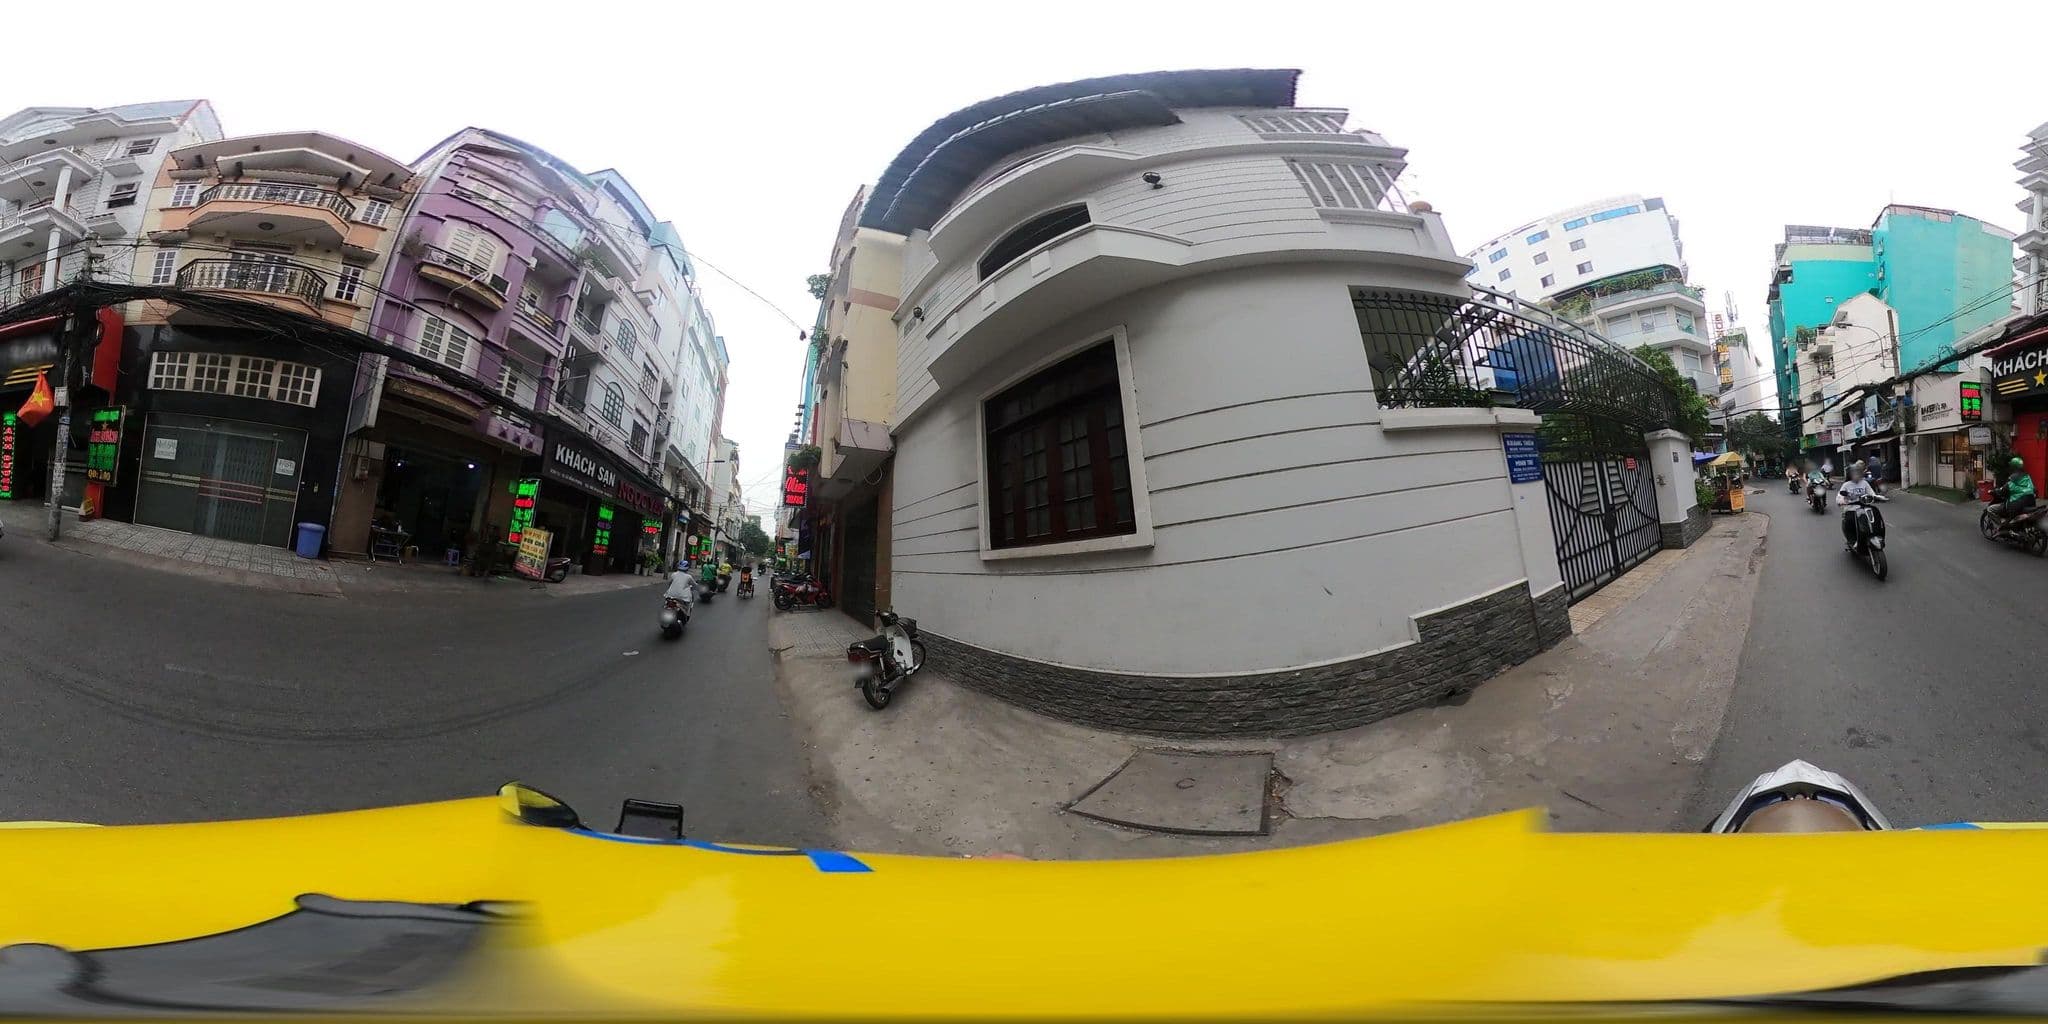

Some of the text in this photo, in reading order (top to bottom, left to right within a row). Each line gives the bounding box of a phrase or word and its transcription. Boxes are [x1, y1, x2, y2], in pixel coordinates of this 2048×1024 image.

[1993, 348, 2048, 379] KHÁCH
[555, 443, 596, 478] KHÁCH
[597, 466, 616, 488] SẠN
